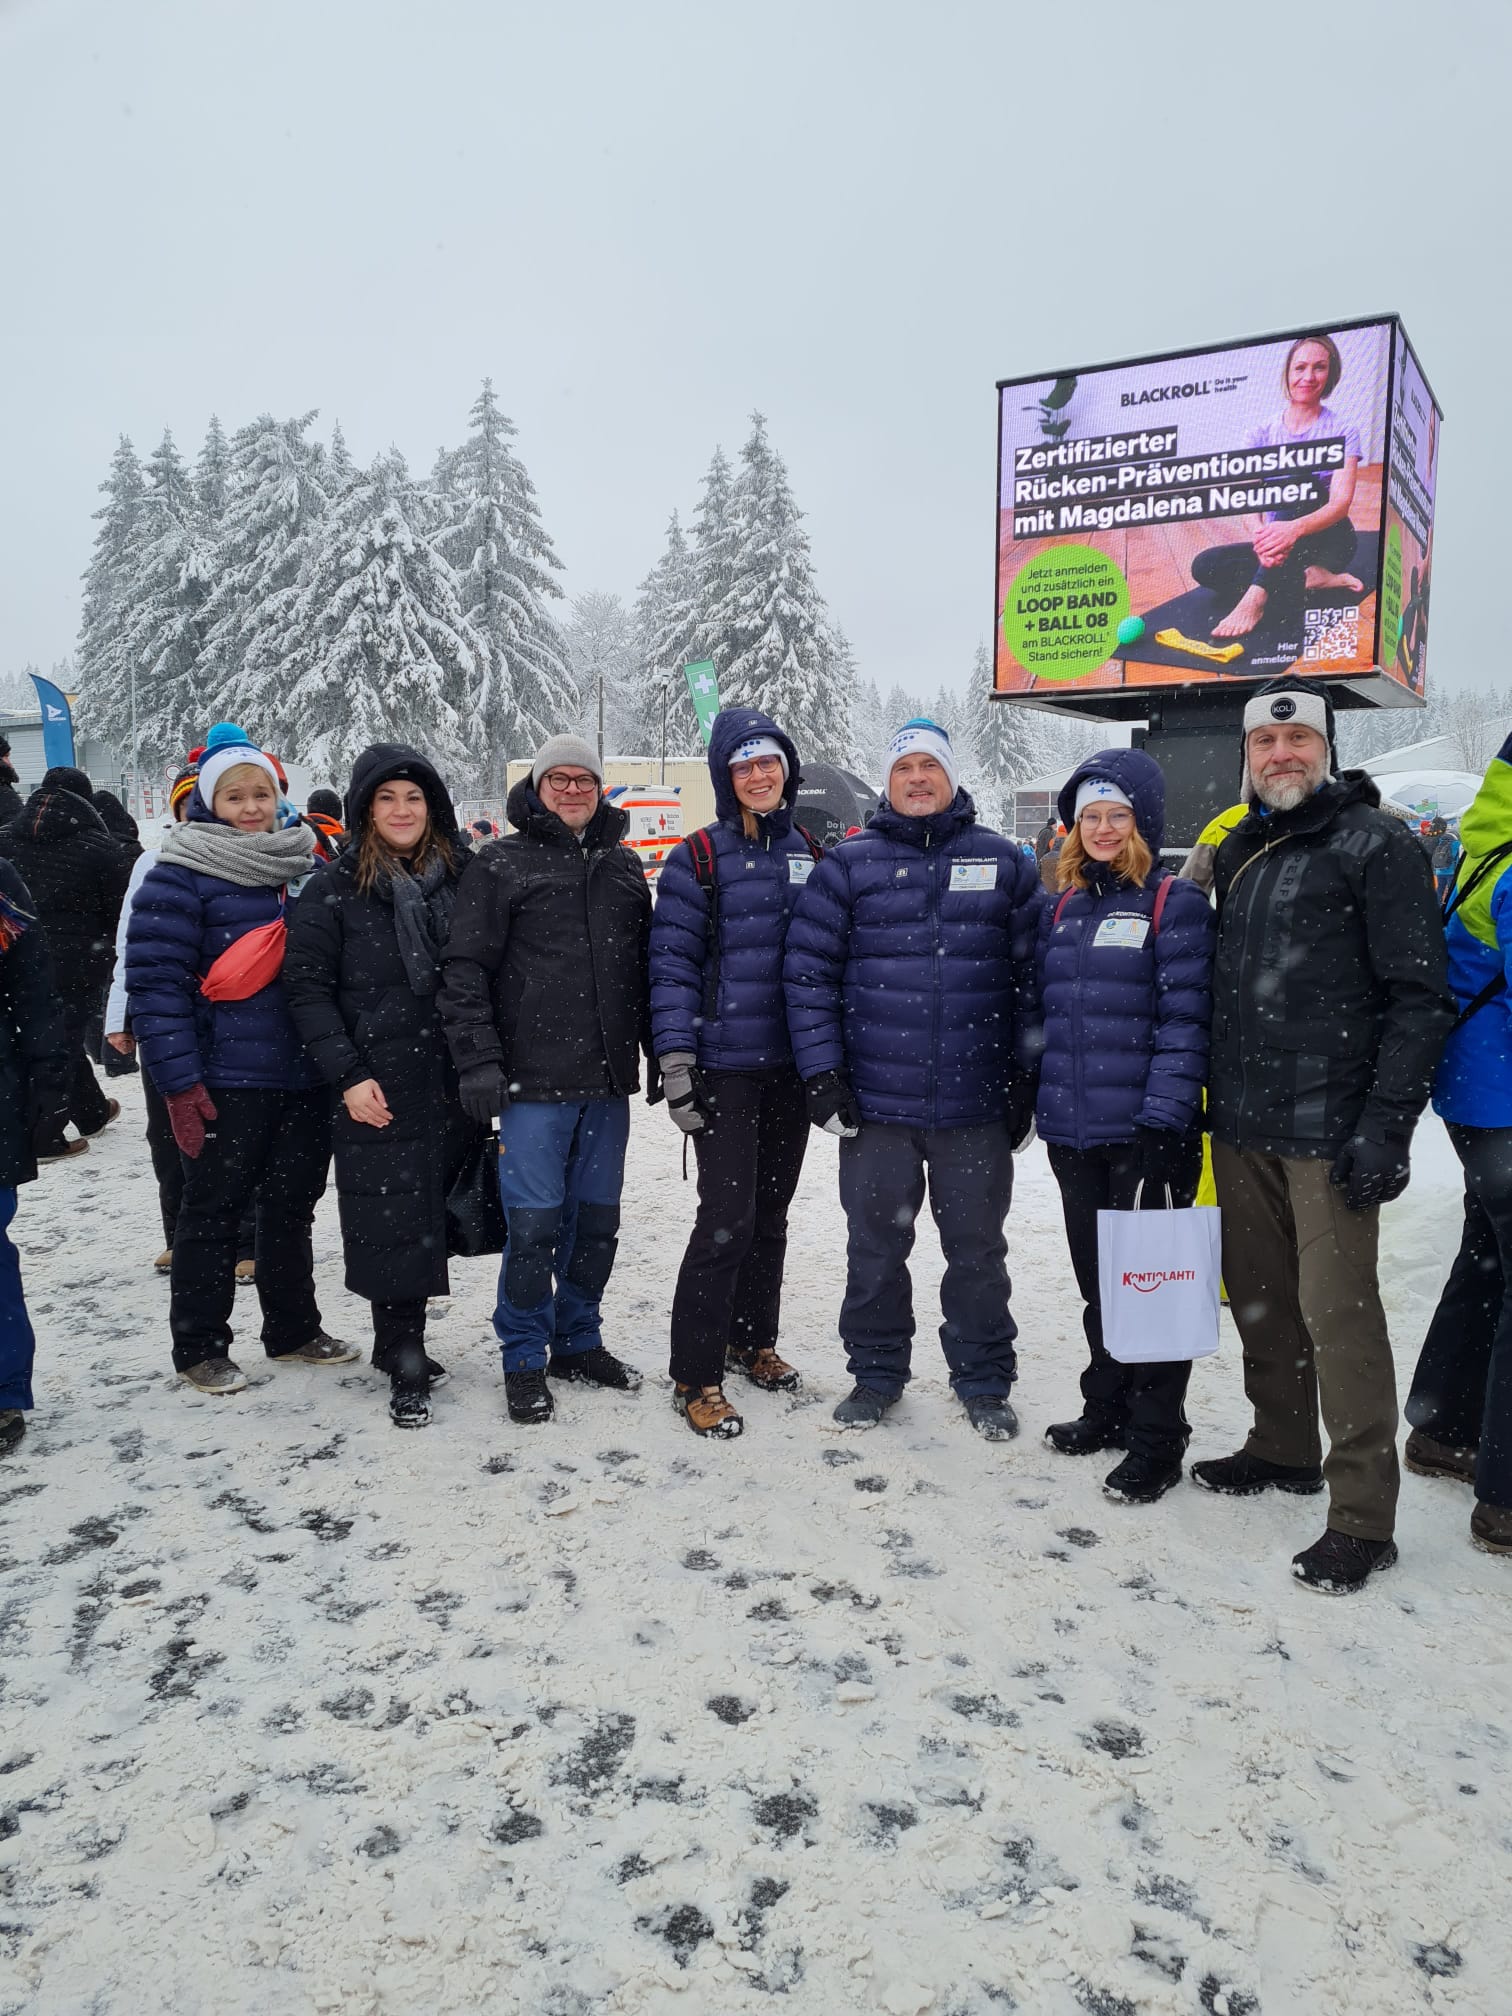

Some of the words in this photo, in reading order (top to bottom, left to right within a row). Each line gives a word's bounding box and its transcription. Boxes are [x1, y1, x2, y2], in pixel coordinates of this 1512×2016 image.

[1214, 384, 1237, 393] health
[1015, 432, 1177, 471] Zertifizierter
[1015, 443, 1343, 503] Rücken-Präventionskurs
[1015, 510, 1054, 534] mit
[1060, 496, 1203, 529] Magdalena
[1209, 481, 1318, 511] Neuner.
[1028, 569, 1052, 580] Jetzt
[1055, 563, 1107, 576] anmelden
[1022, 584, 1041, 594] und
[1044, 578, 1095, 592] zusätzlich
[1098, 577, 1114, 587] ein
[1017, 596, 1064, 614] LOOP
[1067, 592, 1118, 610] BAND
[1039, 615, 1082, 632] BALL
[1086, 612, 1109, 628] 08
[1022, 640, 1038, 649] am
[1278, 642, 1298, 651] Hier
[1029, 650, 1059, 662] Stand
[1061, 647, 1103, 660] sichern!
[1251, 654, 1298, 665] anmelden
[1274, 704, 1293, 713] KOLI
[1122, 1270, 1196, 1289] KONTIOLAHTI
